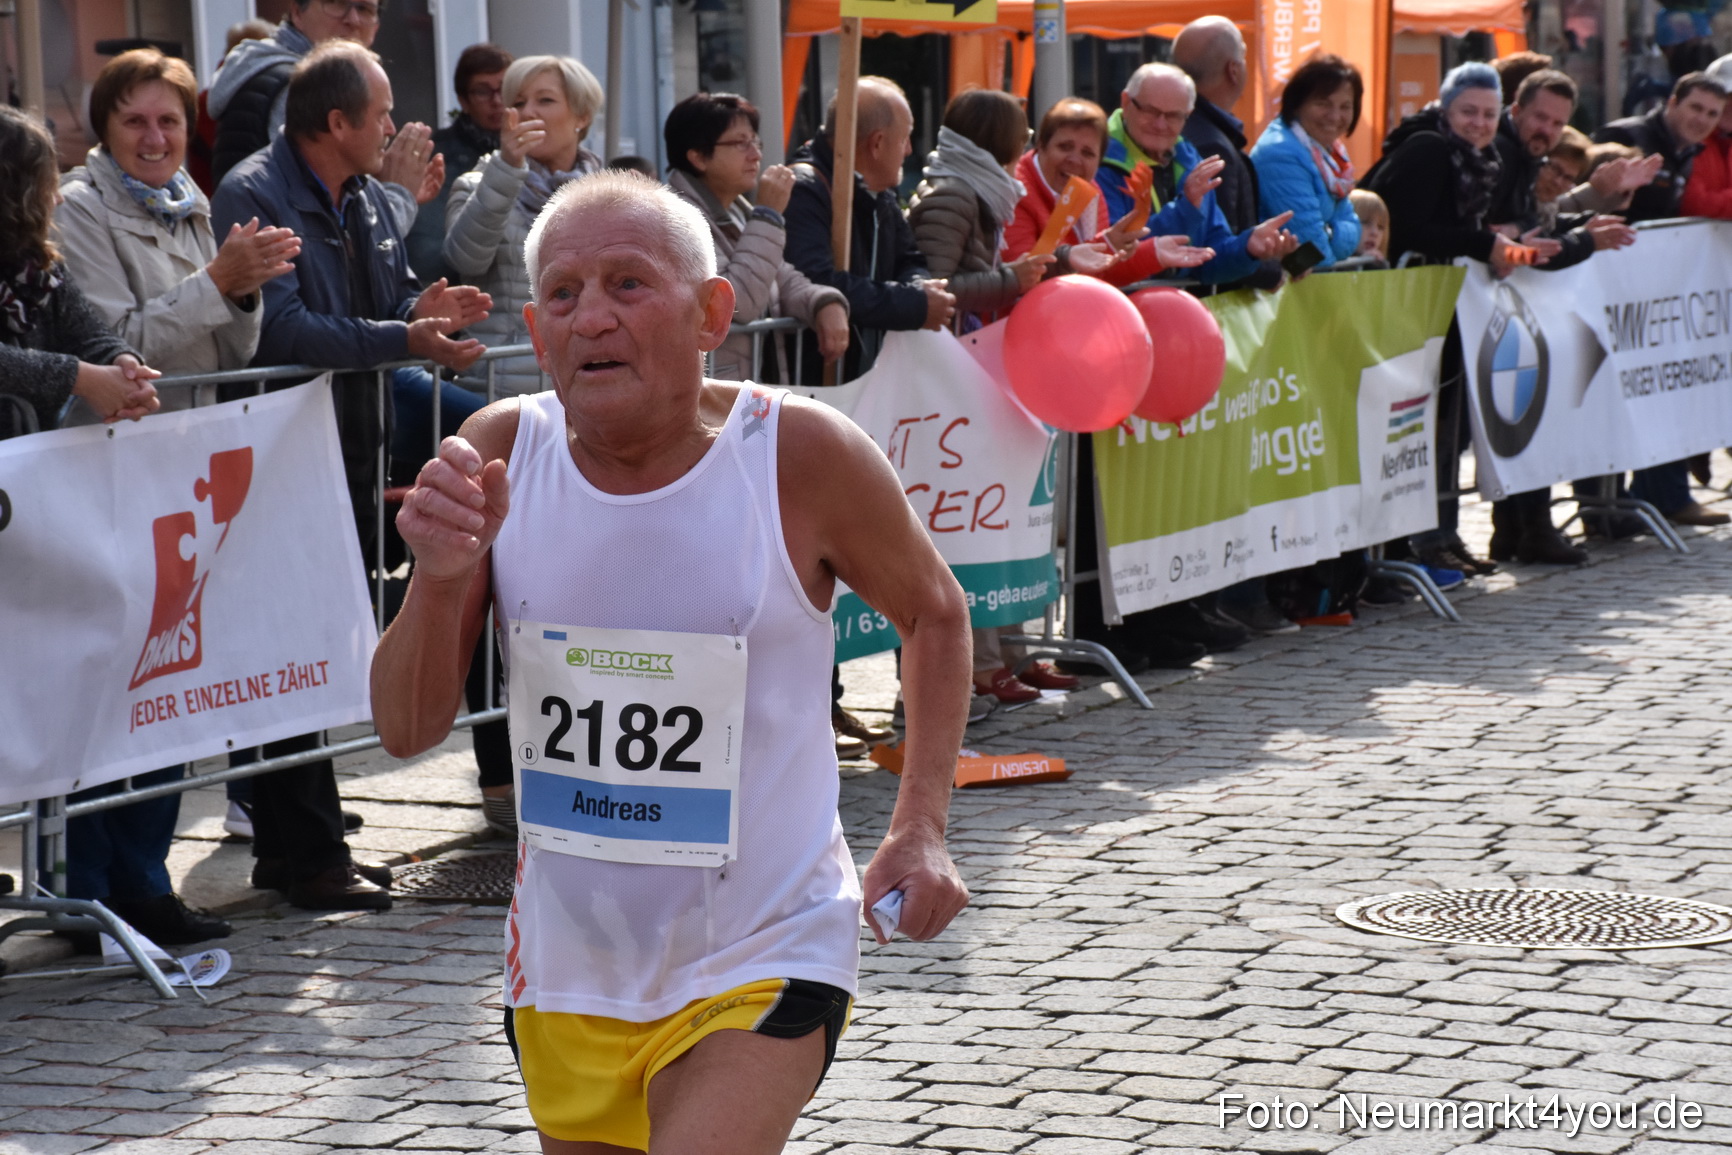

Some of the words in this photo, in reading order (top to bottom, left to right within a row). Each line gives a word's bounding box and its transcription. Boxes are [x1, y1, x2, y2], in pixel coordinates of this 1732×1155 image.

[590, 649, 673, 673] BOCK
[590, 669, 615, 677] inspired
[616, 670, 624, 678] by
[645, 673, 674, 681] concepts
[130, 694, 179, 734] JEDER
[184, 673, 273, 715] EINZELNE
[277, 661, 329, 694] ZÄHLT
[541, 695, 703, 773] 2182
[525, 747, 533, 760] D
[1000, 760, 1049, 778] DESIGN
[572, 790, 662, 822] Andreas
